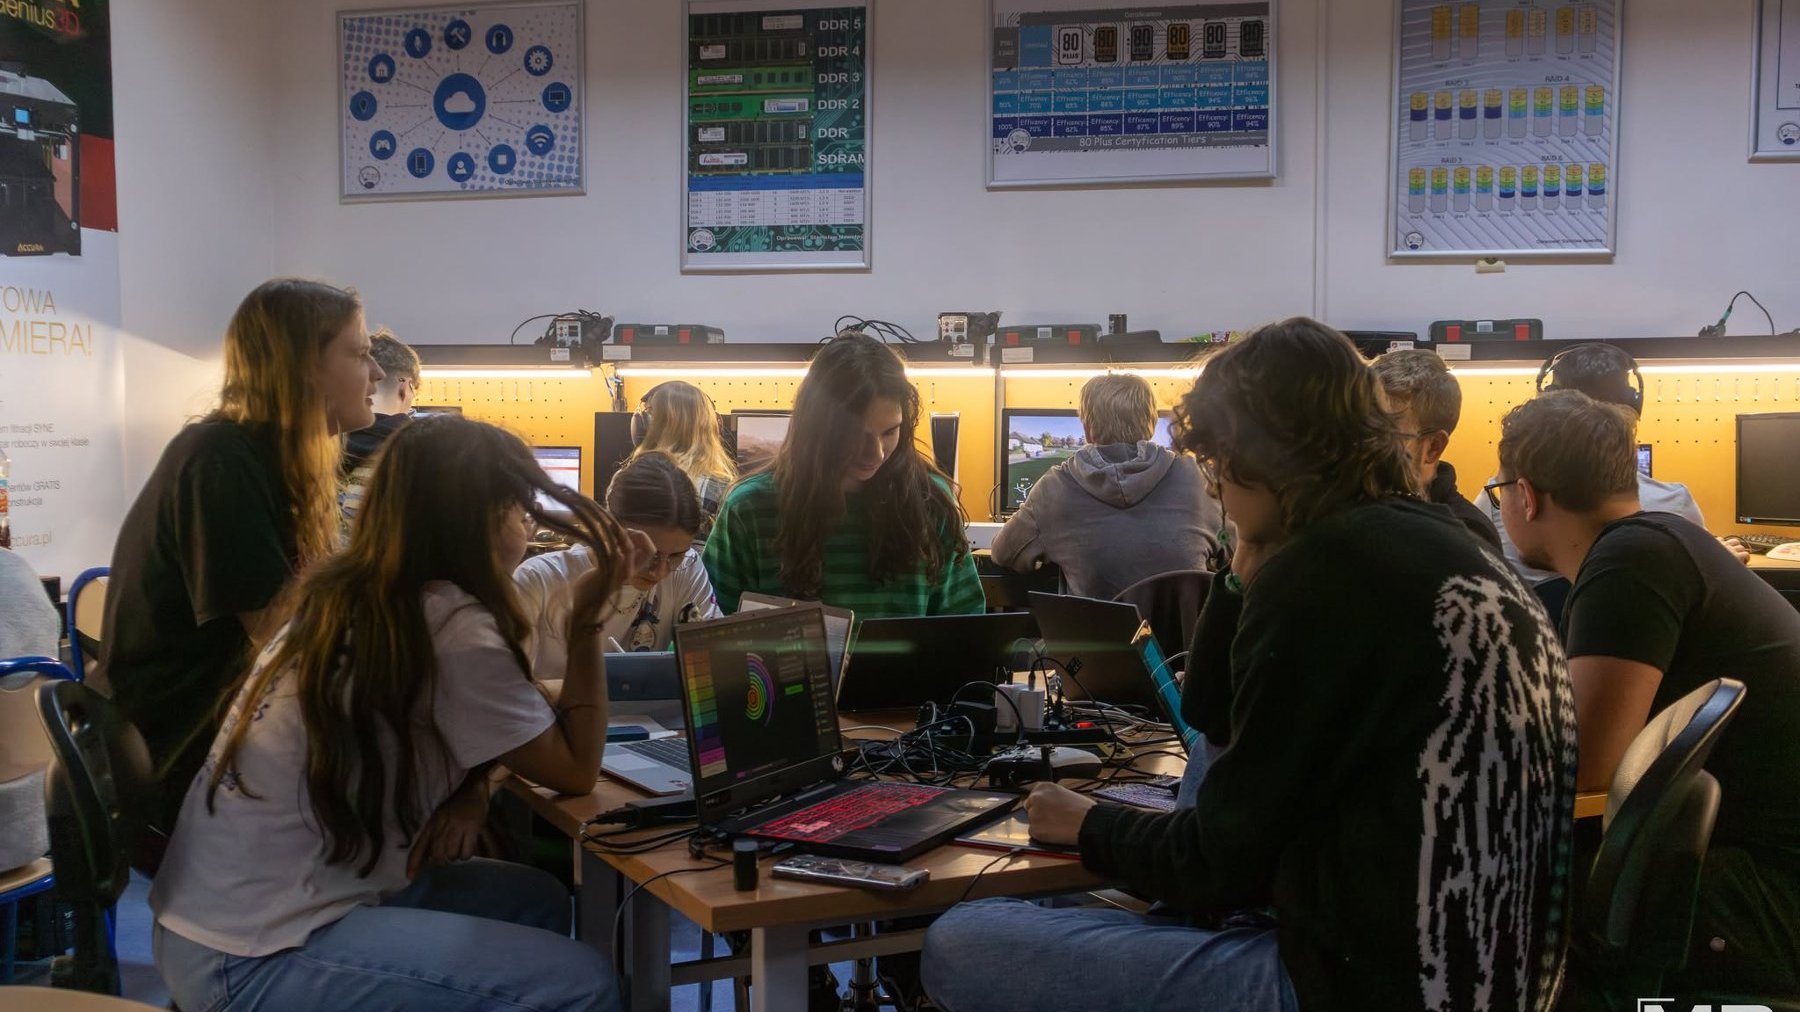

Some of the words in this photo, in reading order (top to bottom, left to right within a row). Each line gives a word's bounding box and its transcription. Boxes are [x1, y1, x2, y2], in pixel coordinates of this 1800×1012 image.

[819, 19, 849, 30] DDR
[853, 18, 861, 29] 5
[1134, 28, 1150, 46] 80
[1170, 26, 1187, 45] 80
[1207, 25, 1223, 44] 80
[1063, 32, 1079, 51] 80
[818, 46, 848, 57] DDR
[852, 45, 860, 56] 4
[818, 72, 848, 84] DDR
[852, 71, 860, 83] 3
[818, 98, 848, 110] DDR
[851, 97, 860, 109] 2
[818, 127, 848, 138] DDR
[1080, 137, 1092, 147] 80
[1094, 136, 1114, 147] Plus
[1182, 133, 1208, 144] Tiers
